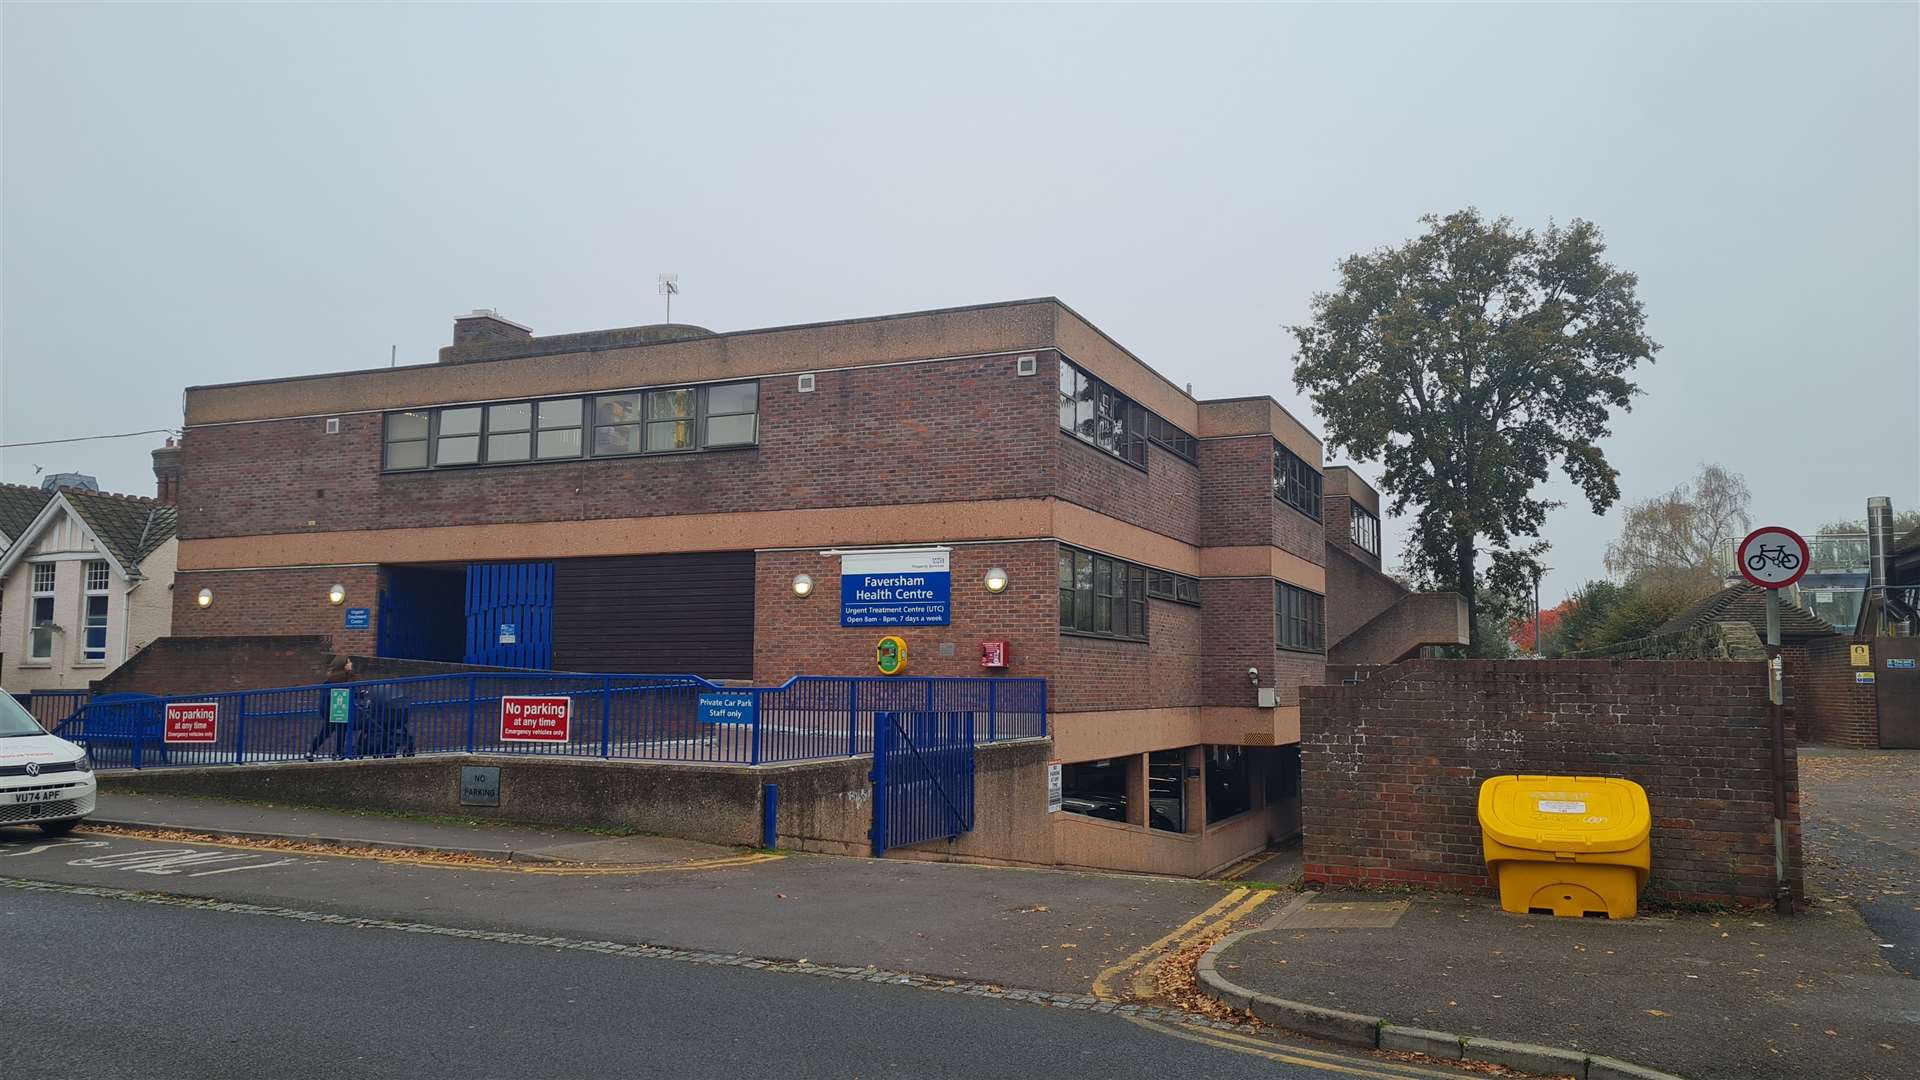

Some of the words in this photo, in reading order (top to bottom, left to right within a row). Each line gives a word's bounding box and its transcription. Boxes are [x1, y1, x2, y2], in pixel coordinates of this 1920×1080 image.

[865, 576, 924, 587] Faversham
[856, 589, 892, 600] Health
[896, 588, 934, 599] Centre
[846, 608, 867, 616] Urgent
[168, 709, 180, 719] No
[183, 708, 214, 721] parking
[506, 702, 520, 714] No
[524, 702, 564, 718] parking
[727, 710, 742, 719] only
[523, 719, 537, 728] any
[539, 718, 556, 726] time
[16, 793, 40, 802] VU74
[42, 790, 60, 800] APF
